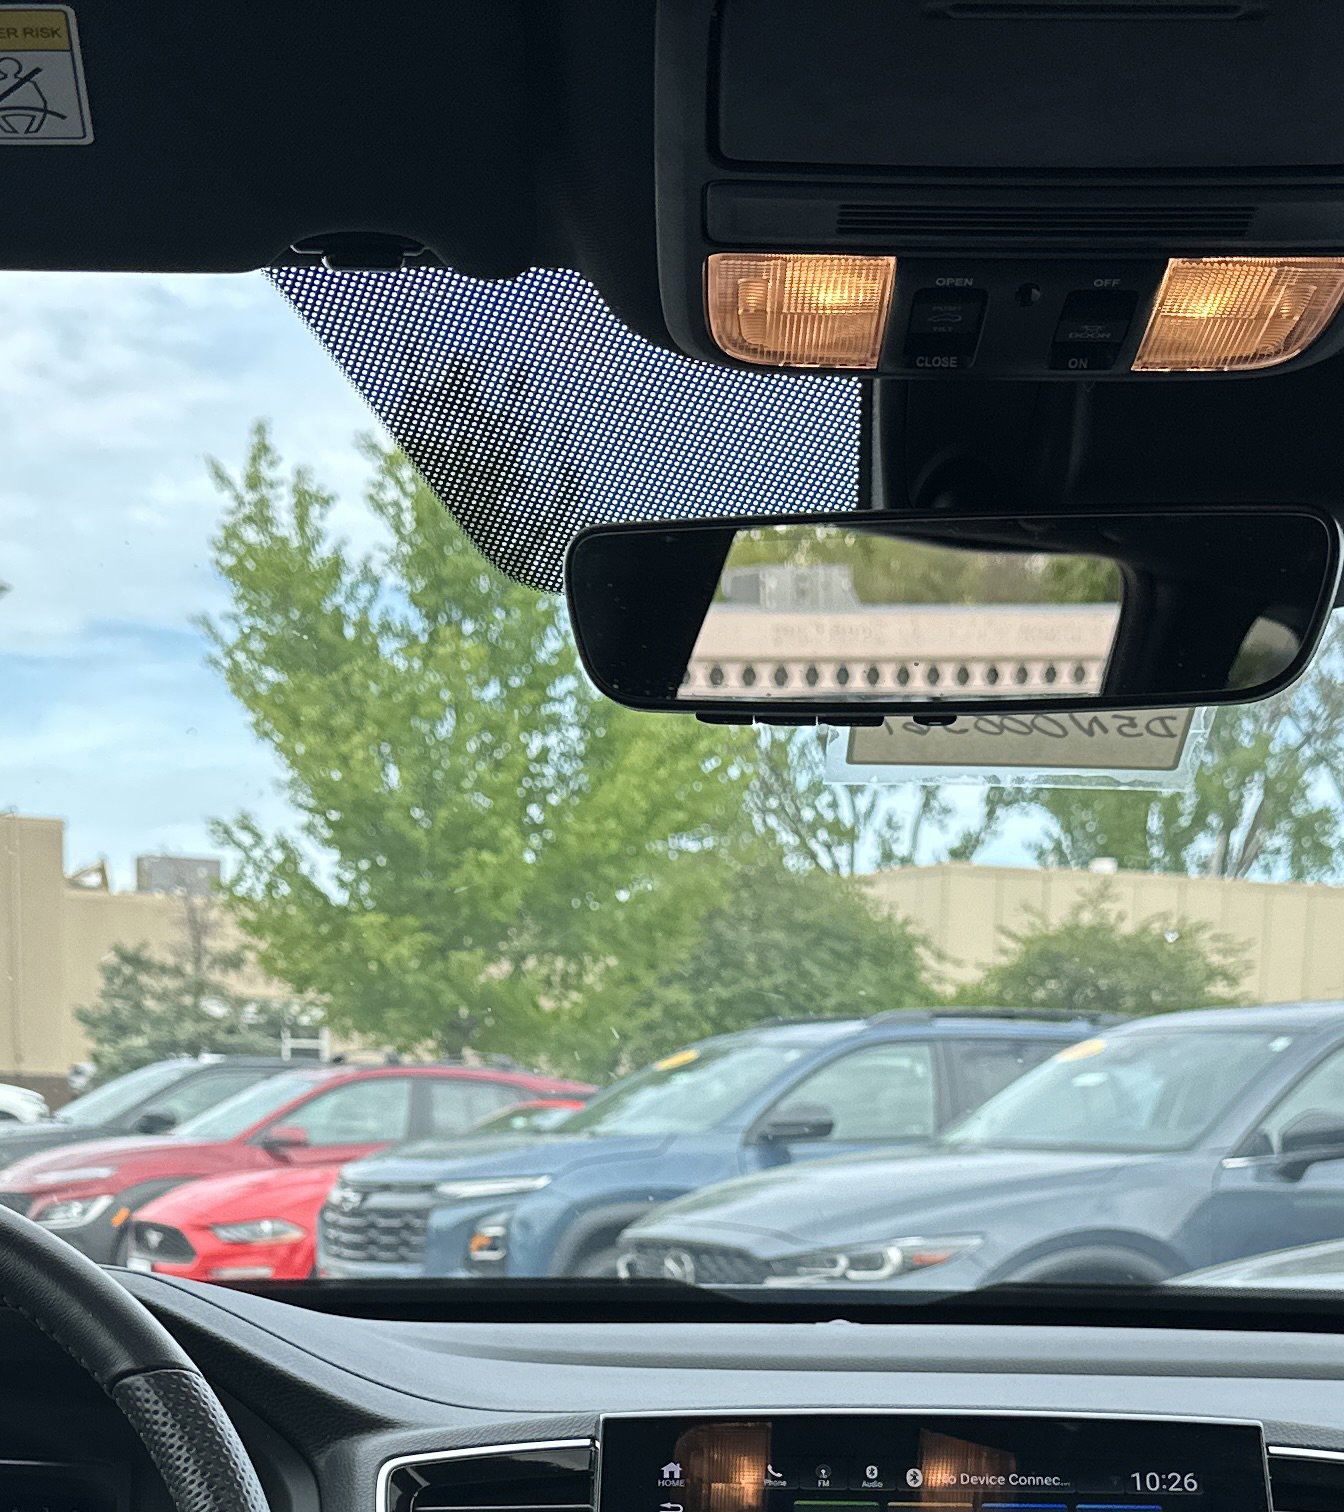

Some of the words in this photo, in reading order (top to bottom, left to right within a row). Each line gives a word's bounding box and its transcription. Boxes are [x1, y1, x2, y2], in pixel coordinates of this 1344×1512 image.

[22, 27, 62, 40] RISK
[935, 277, 974, 287] OPEN
[1093, 278, 1121, 288] OFF
[915, 356, 958, 368] CLOSE
[1068, 358, 1089, 369] ON
[657, 1479, 685, 1488] HOME
[817, 1479, 830, 1488] FM
[959, 1472, 1006, 1486] Device
[1129, 1470, 1199, 1494] 10:26
